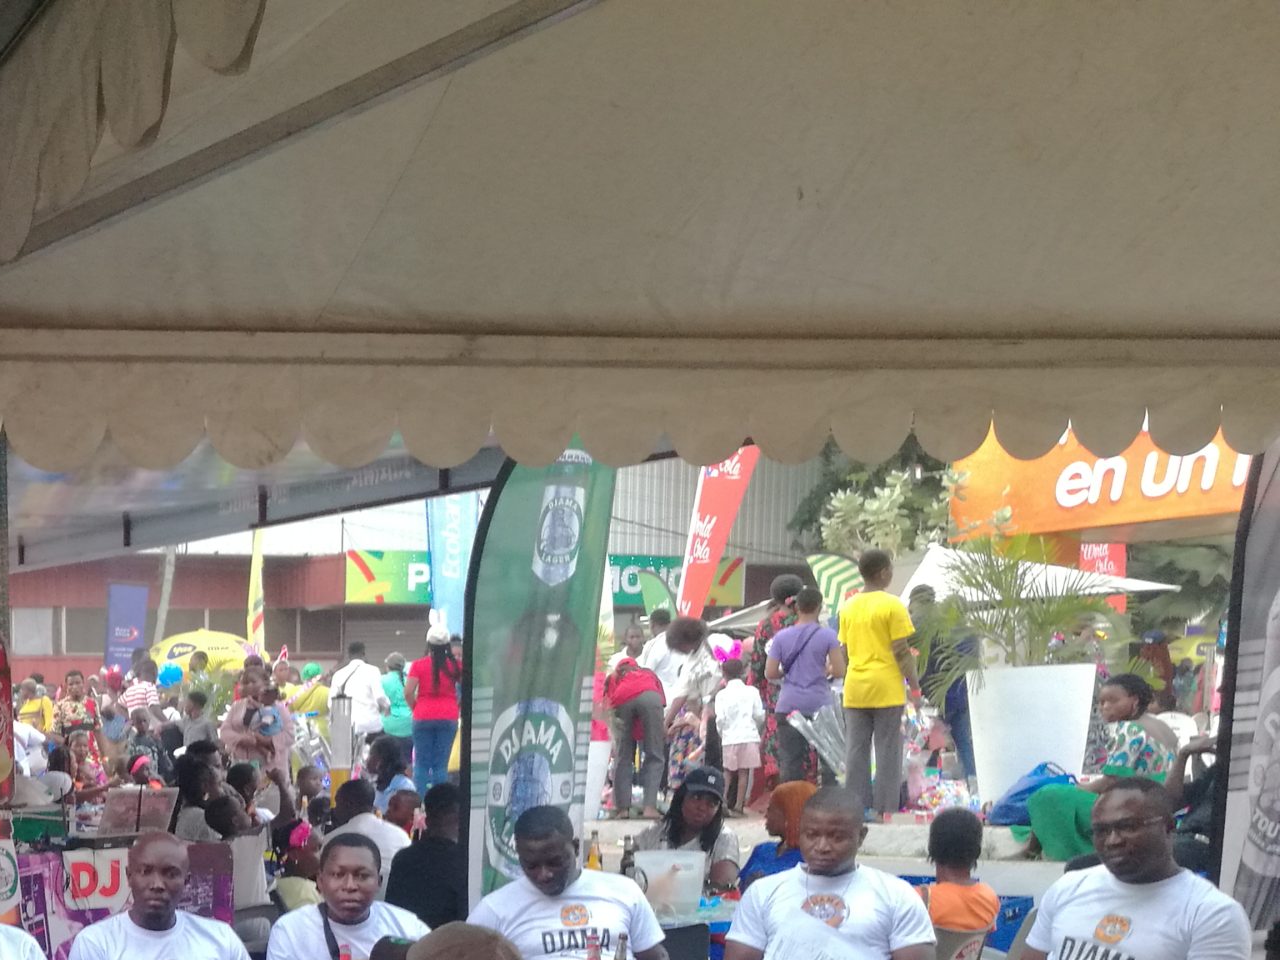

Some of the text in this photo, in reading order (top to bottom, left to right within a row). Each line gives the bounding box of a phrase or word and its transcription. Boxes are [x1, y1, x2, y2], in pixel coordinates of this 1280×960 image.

[1055, 454, 1128, 508] en
[1140, 442, 1220, 498] un
[499, 719, 563, 764] DJAMA
[70, 859, 121, 900] DJ
